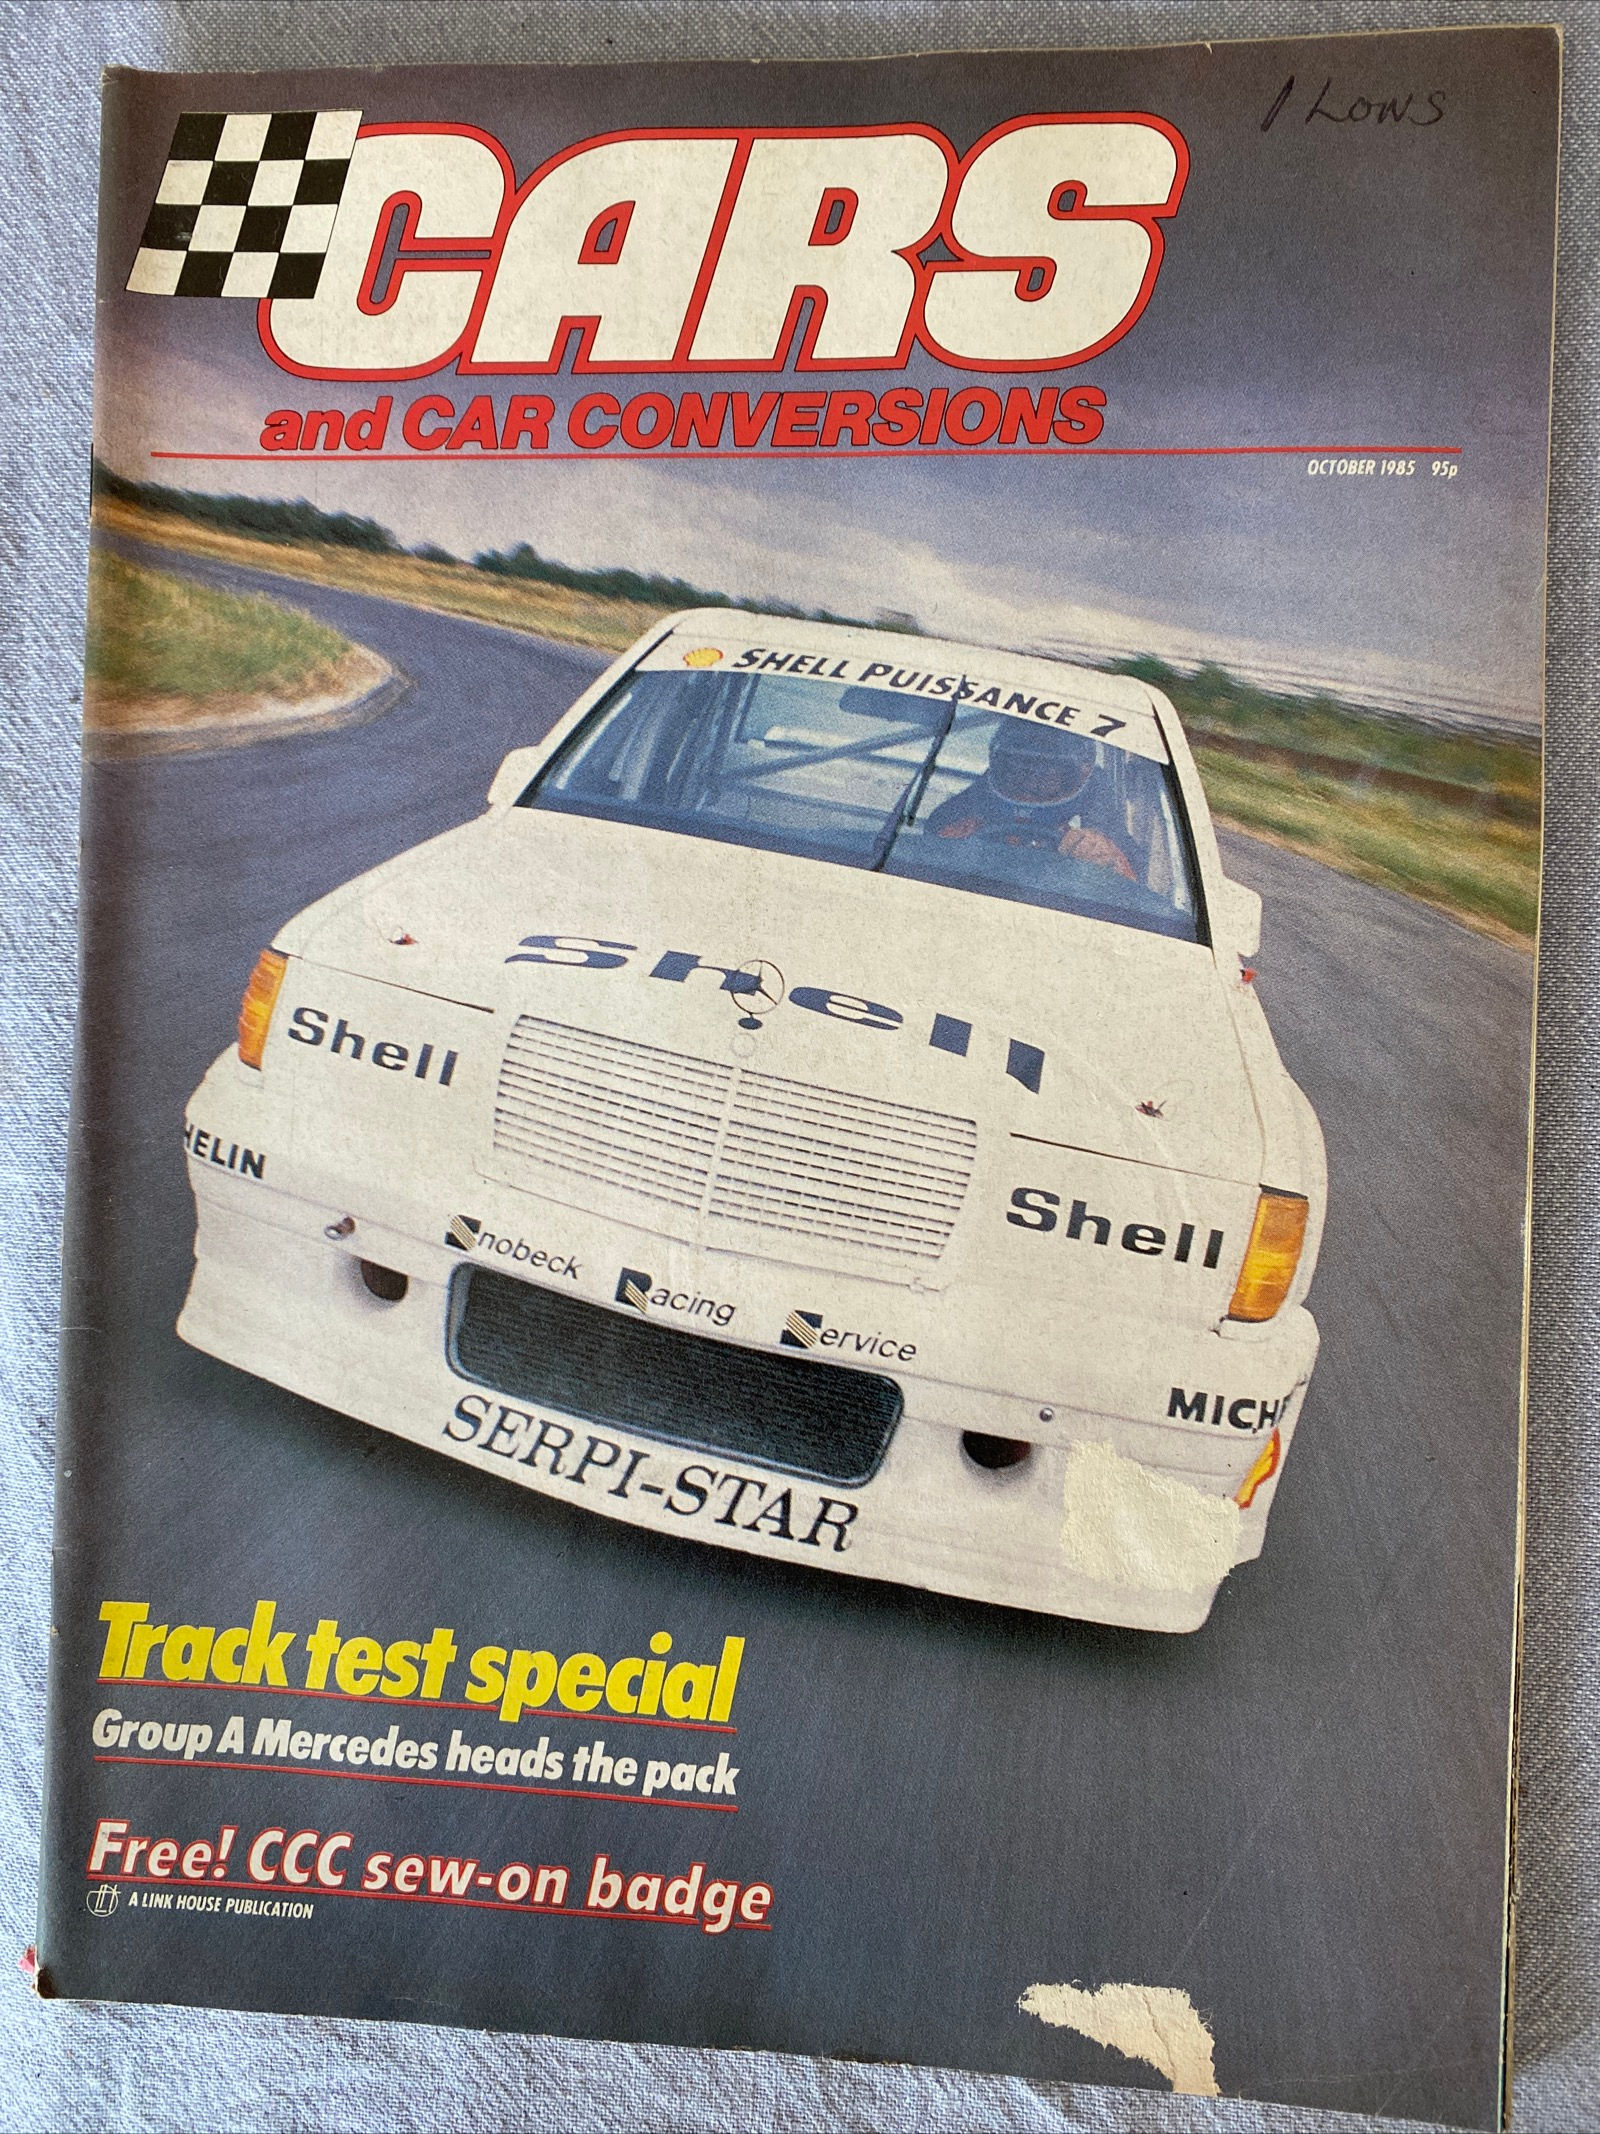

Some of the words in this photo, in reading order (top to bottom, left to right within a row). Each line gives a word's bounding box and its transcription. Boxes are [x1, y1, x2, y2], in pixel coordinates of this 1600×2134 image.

[257, 111, 1190, 382] CARS
[260, 395, 393, 452] and
[400, 394, 555, 450] CAR
[567, 387, 1107, 450] CONVERSIONS
[1307, 459, 1377, 476] OCTOBER
[1380, 459, 1416, 476] 1985
[1431, 460, 1459, 479] 95p
[732, 648, 850, 679] SHELL
[858, 662, 1081, 728] PUISSANCE
[1089, 714, 1127, 738] 7
[287, 1006, 460, 1087] Shell
[504, 935, 1045, 1095] Shell
[1006, 1187, 1224, 1269] Shell
[614, 1267, 735, 1326] Racing
[780, 1309, 917, 1361] Service
[442, 1394, 860, 1553] SERPI-STAR
[98, 1601, 296, 1686] Track
[305, 1619, 456, 1699] test
[464, 1631, 745, 1723] special
[92, 1708, 212, 1760] Group
[216, 1720, 245, 1755] A
[251, 1721, 438, 1772] Mercedes
[446, 1730, 562, 1780] heads
[571, 1741, 637, 1787] the
[641, 1752, 739, 1798] pack
[88, 1818, 237, 1881] Free!
[246, 1826, 354, 1890] CCC
[362, 1851, 569, 1907] sew-on
[585, 1854, 774, 1935] badge
[128, 1891, 138, 1907] A
[142, 1893, 172, 1910] LINK
[176, 1896, 222, 1913] HOUSE
[225, 1898, 314, 1920] PUBLICATION
